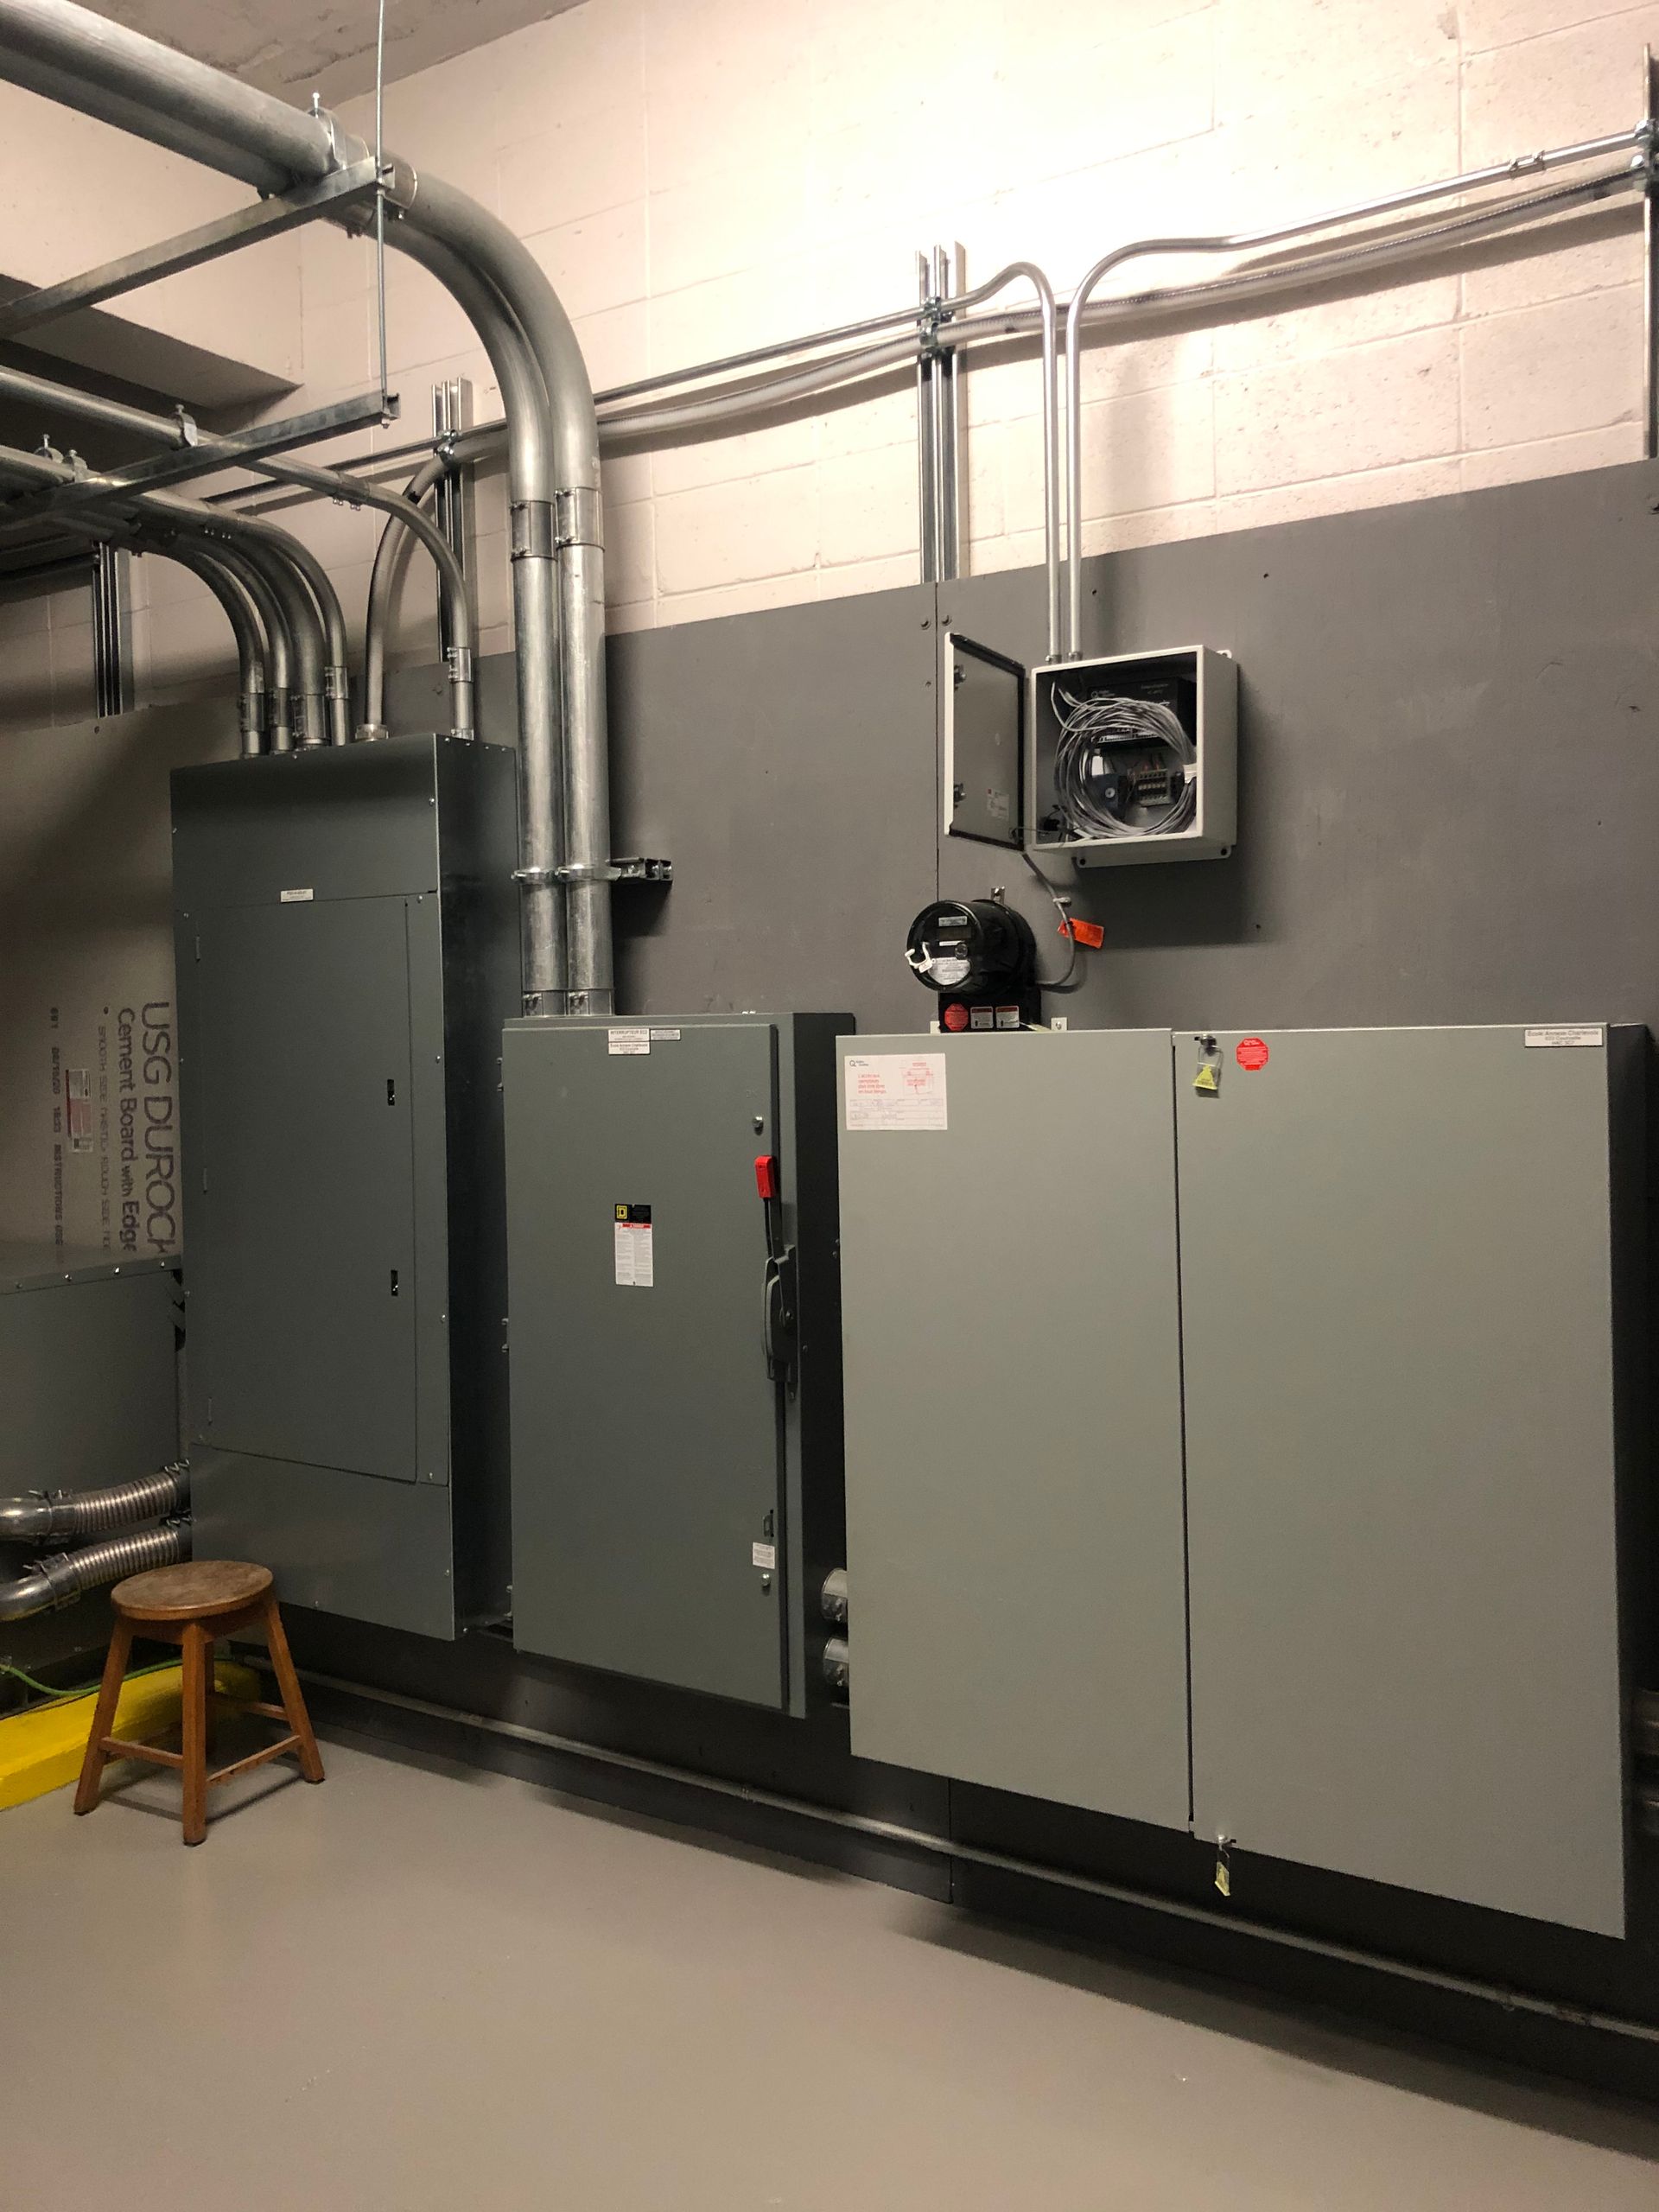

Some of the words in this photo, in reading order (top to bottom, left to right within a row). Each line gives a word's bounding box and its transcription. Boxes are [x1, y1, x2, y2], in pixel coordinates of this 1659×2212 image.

[118, 1007, 136, 1092] Cement
[142, 1002, 172, 1084] USG
[120, 1098, 138, 1160] Board
[122, 1166, 133, 1197] with
